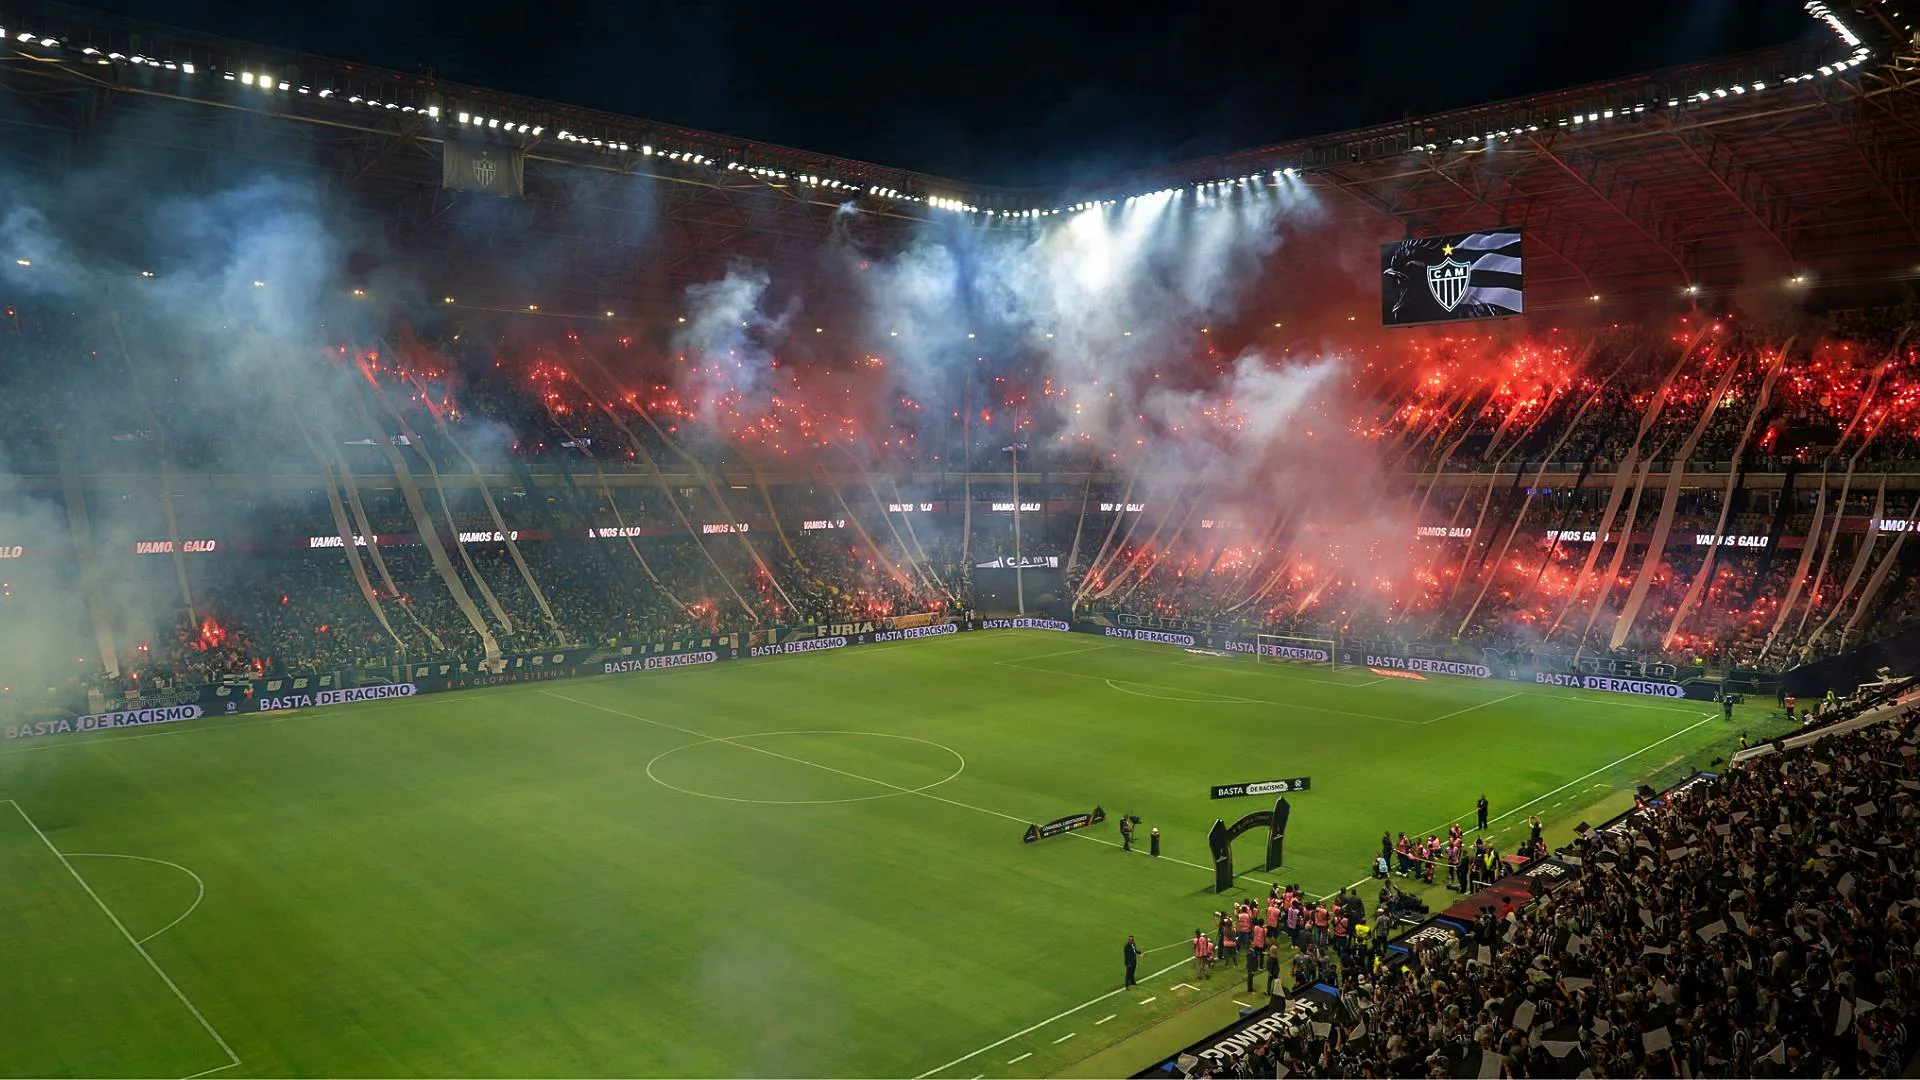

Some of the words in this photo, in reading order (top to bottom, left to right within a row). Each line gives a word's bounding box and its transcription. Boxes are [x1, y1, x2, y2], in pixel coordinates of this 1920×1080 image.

[1434, 267, 1464, 278] CAM
[1020, 503, 1040, 511] GALO
[703, 524, 729, 534] VAMOS
[730, 523, 748, 533] GLO
[803, 520, 827, 530] VAMOS
[1870, 519, 1914, 531] AMOS
[459, 532, 491, 543] VAMOS
[493, 531, 517, 542] GAO
[589, 528, 617, 538] VMOS
[1417, 527, 1447, 537] VAMOS
[1449, 528, 1471, 537] GALO
[1583, 531, 1609, 541] GA
[137, 542, 174, 554] VAMO
[184, 540, 215, 552] GALO
[1738, 536, 1768, 547] GALO
[983, 619, 1010, 629] BASTA
[1016, 620, 1029, 628] DE
[1031, 620, 1066, 631] RACISMO
[876, 631, 902, 642] BASTA
[907, 629, 917, 637] DE
[920, 624, 955, 635] RACISMO
[1105, 627, 1132, 638] BASTA
[1137, 631, 1148, 640] DE
[1151, 632, 1191, 645] RACISMO
[751, 643, 782, 657] BASTA
[788, 642, 800, 652] DE
[802, 638, 843, 650] RACISMO
[1224, 640, 1255, 654] BASTA
[1260, 645, 1273, 655] DE
[1276, 646, 1323, 660] RACISMO
[604, 660, 642, 673] BASTA
[648, 658, 662, 668] DE
[665, 652, 713, 666] RACISMO
[1366, 655, 1405, 669] BASTA
[1412, 660, 1428, 671] DE
[1431, 662, 1486, 677] RACISMO
[1536, 672, 1580, 687] BASTA
[1588, 677, 1607, 690] DE
[1611, 680, 1678, 697] RACISMO
[261, 694, 312, 711] BASTA
[322, 691, 340, 704] DE
[344, 685, 411, 701] RACISMO
[6, 719, 71, 739] BASTA
[83, 715, 108, 730] DE
[113, 706, 195, 726] RACISMO
[1218, 786, 1244, 796] BASTA
[1259, 783, 1284, 792] RACISMO
